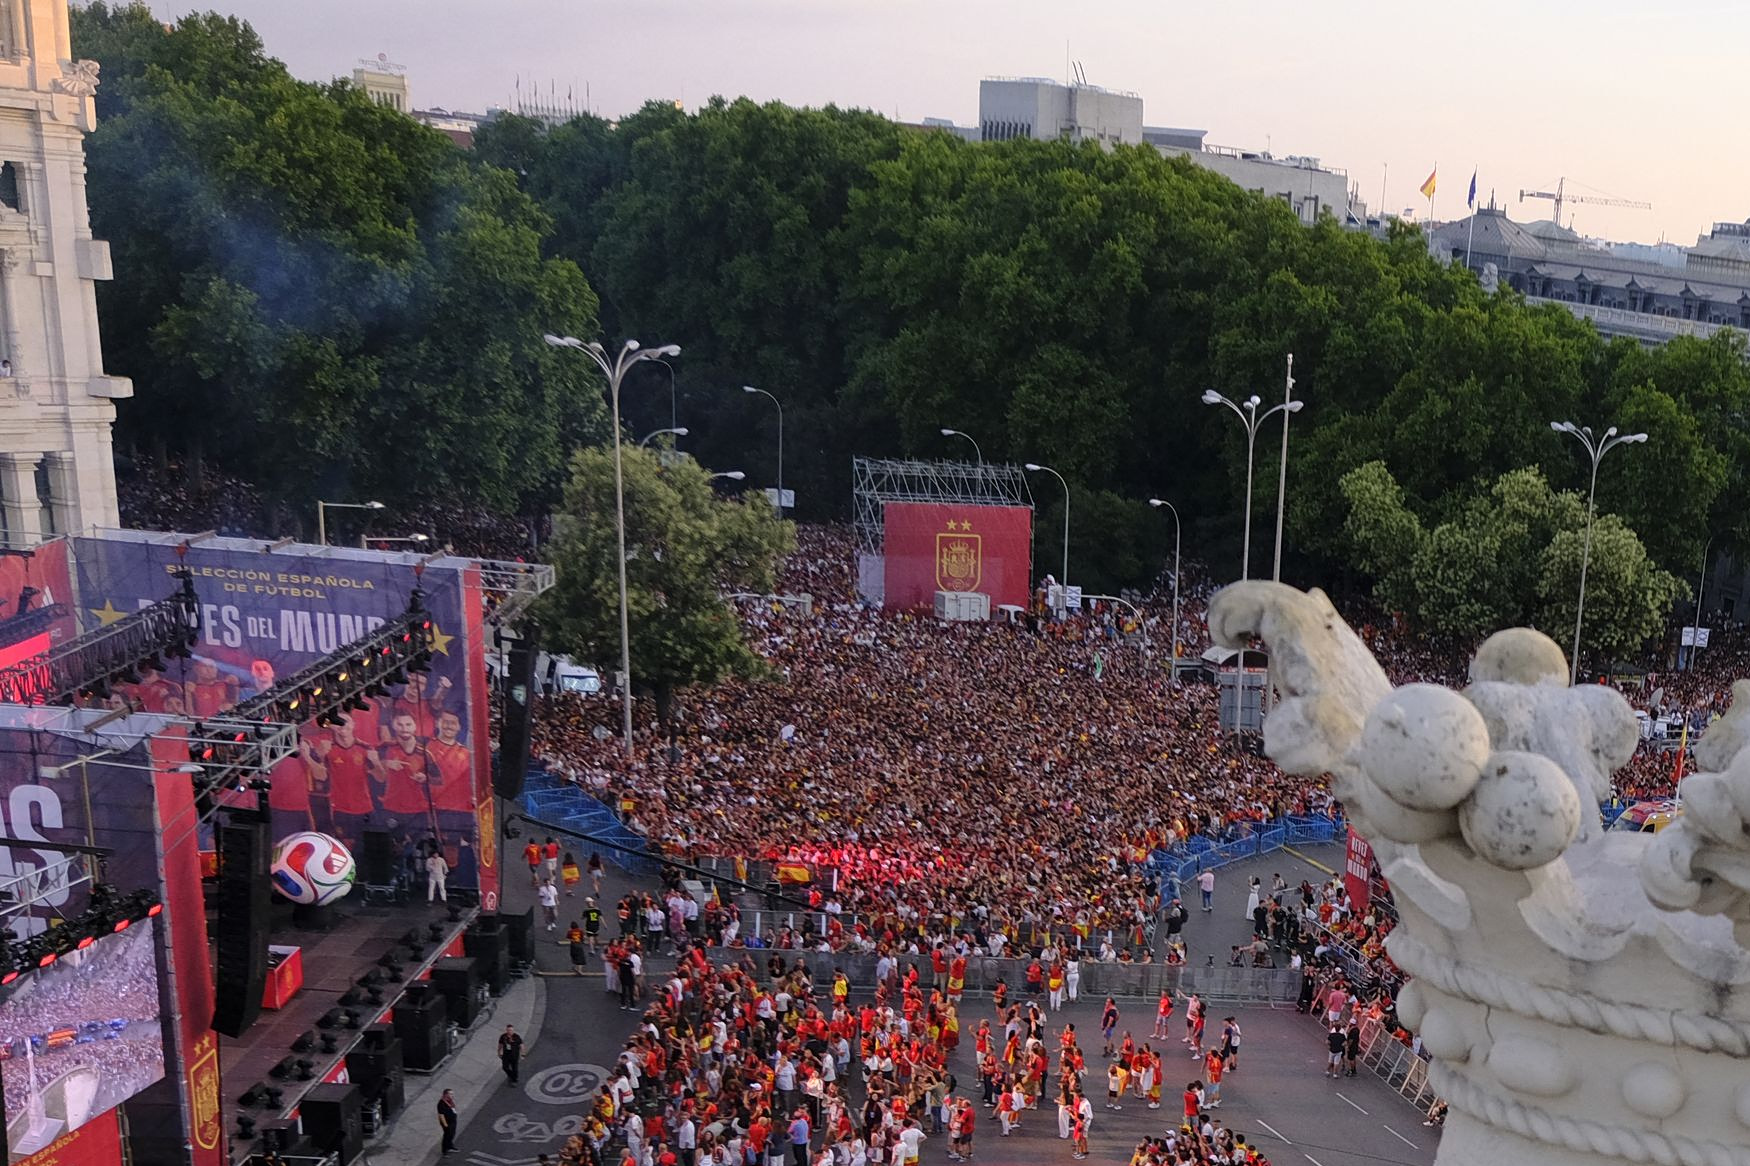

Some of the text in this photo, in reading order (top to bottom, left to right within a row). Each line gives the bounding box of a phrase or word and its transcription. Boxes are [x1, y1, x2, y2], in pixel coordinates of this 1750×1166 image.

[165, 564, 375, 590] SLECCIÓN ESPAÑOLA
[224, 582, 326, 599] DE FÚTBOL
[247, 615, 277, 639] DEL
[545, 1073, 596, 1094] 30
[32, 1130, 80, 1164] ESPAÑOLA
